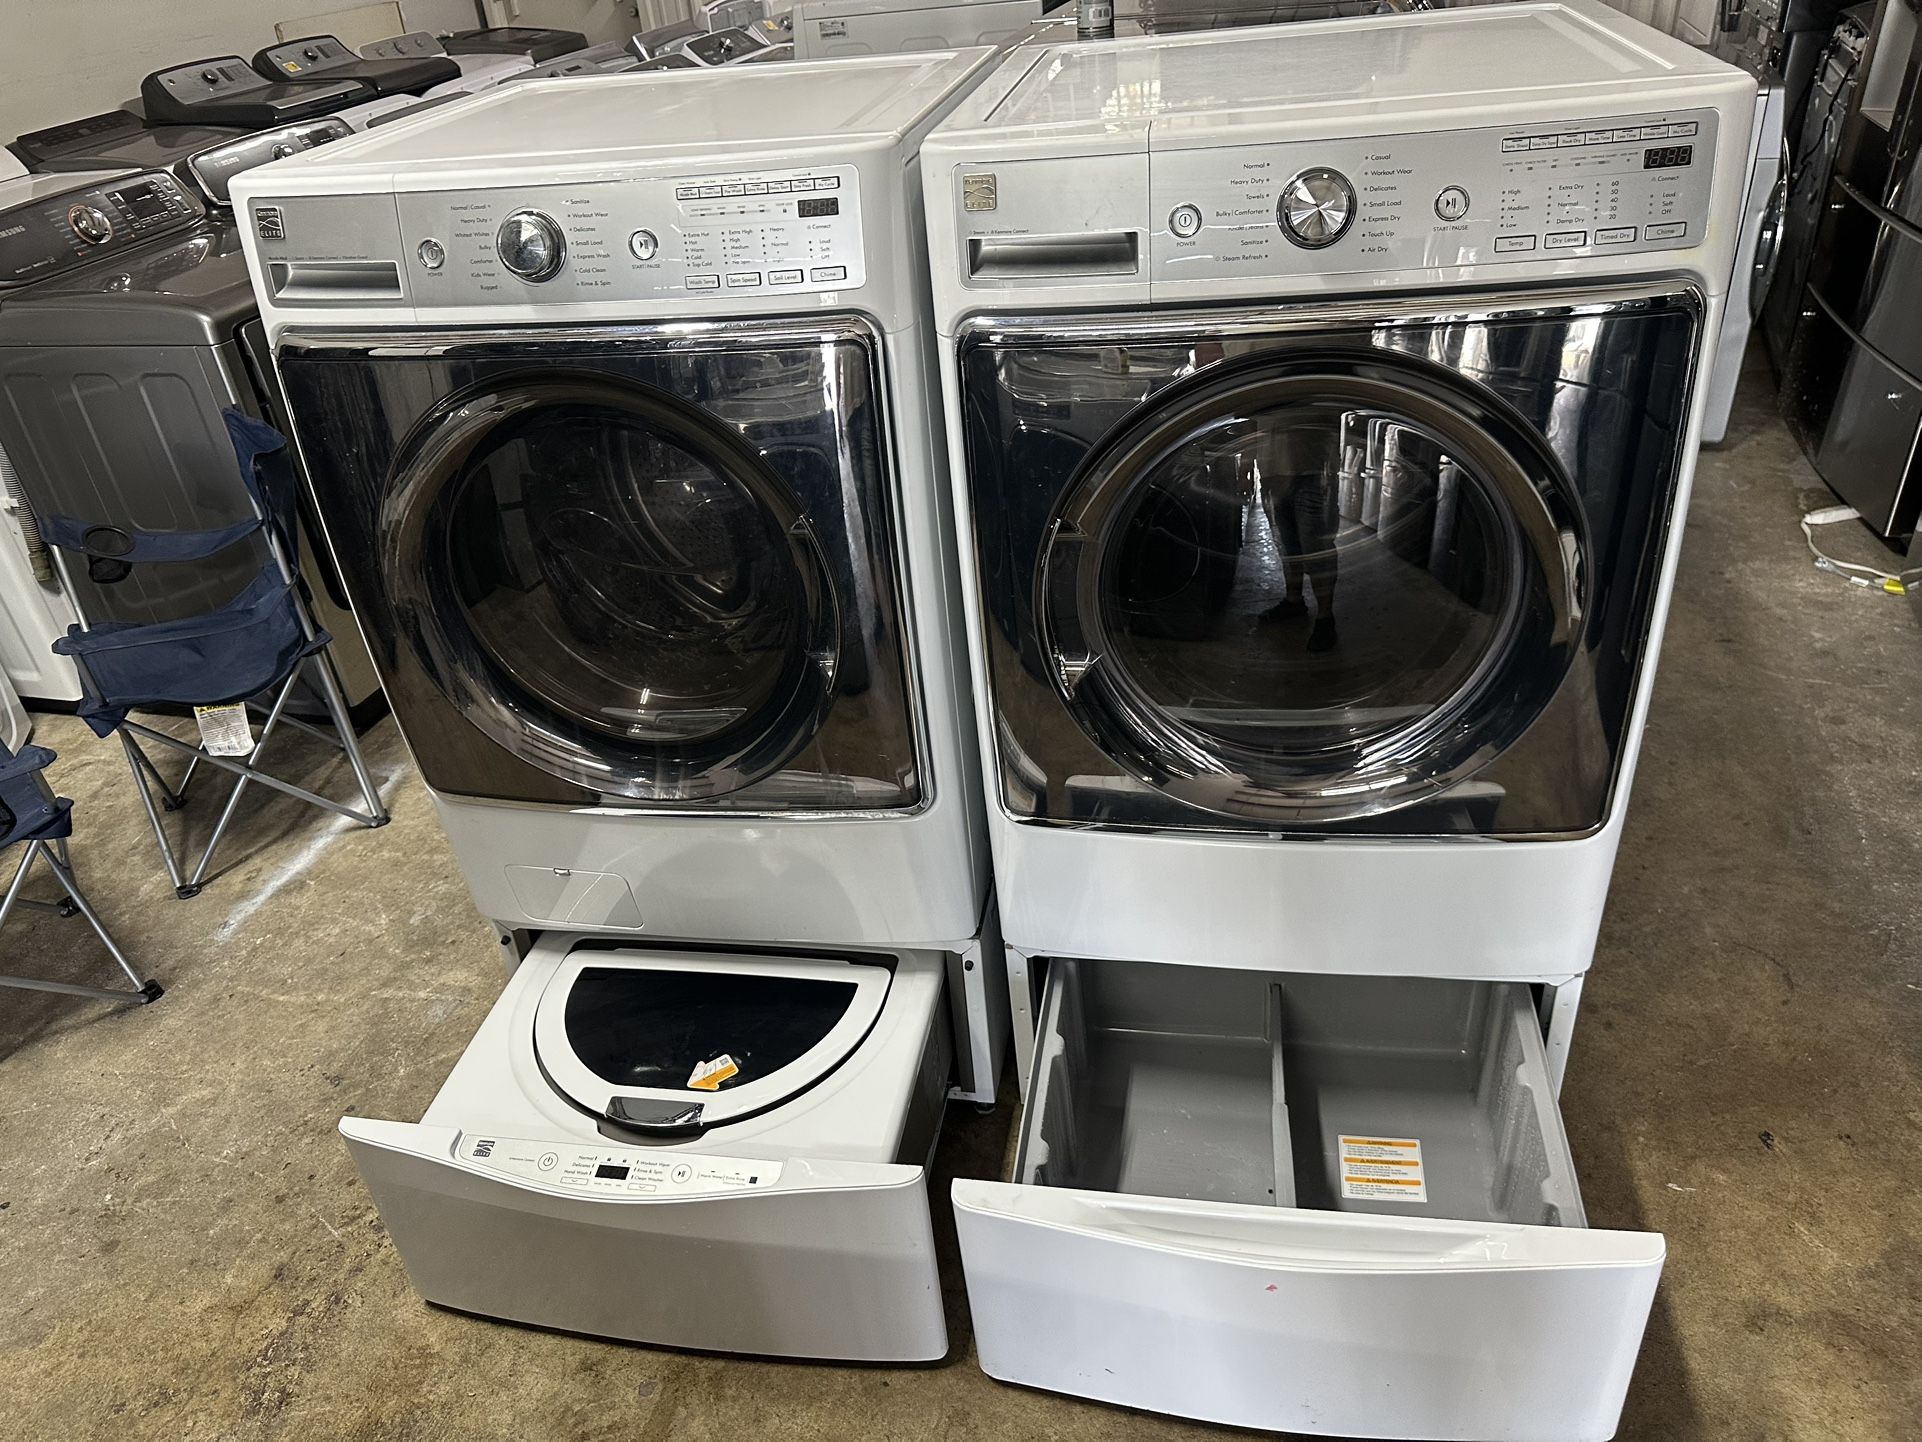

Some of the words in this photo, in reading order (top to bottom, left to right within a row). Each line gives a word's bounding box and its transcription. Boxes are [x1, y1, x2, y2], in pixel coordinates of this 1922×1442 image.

[1370, 153, 1391, 161] Casual
[1507, 188, 1521, 196] High
[1369, 200, 1386, 208] Small
